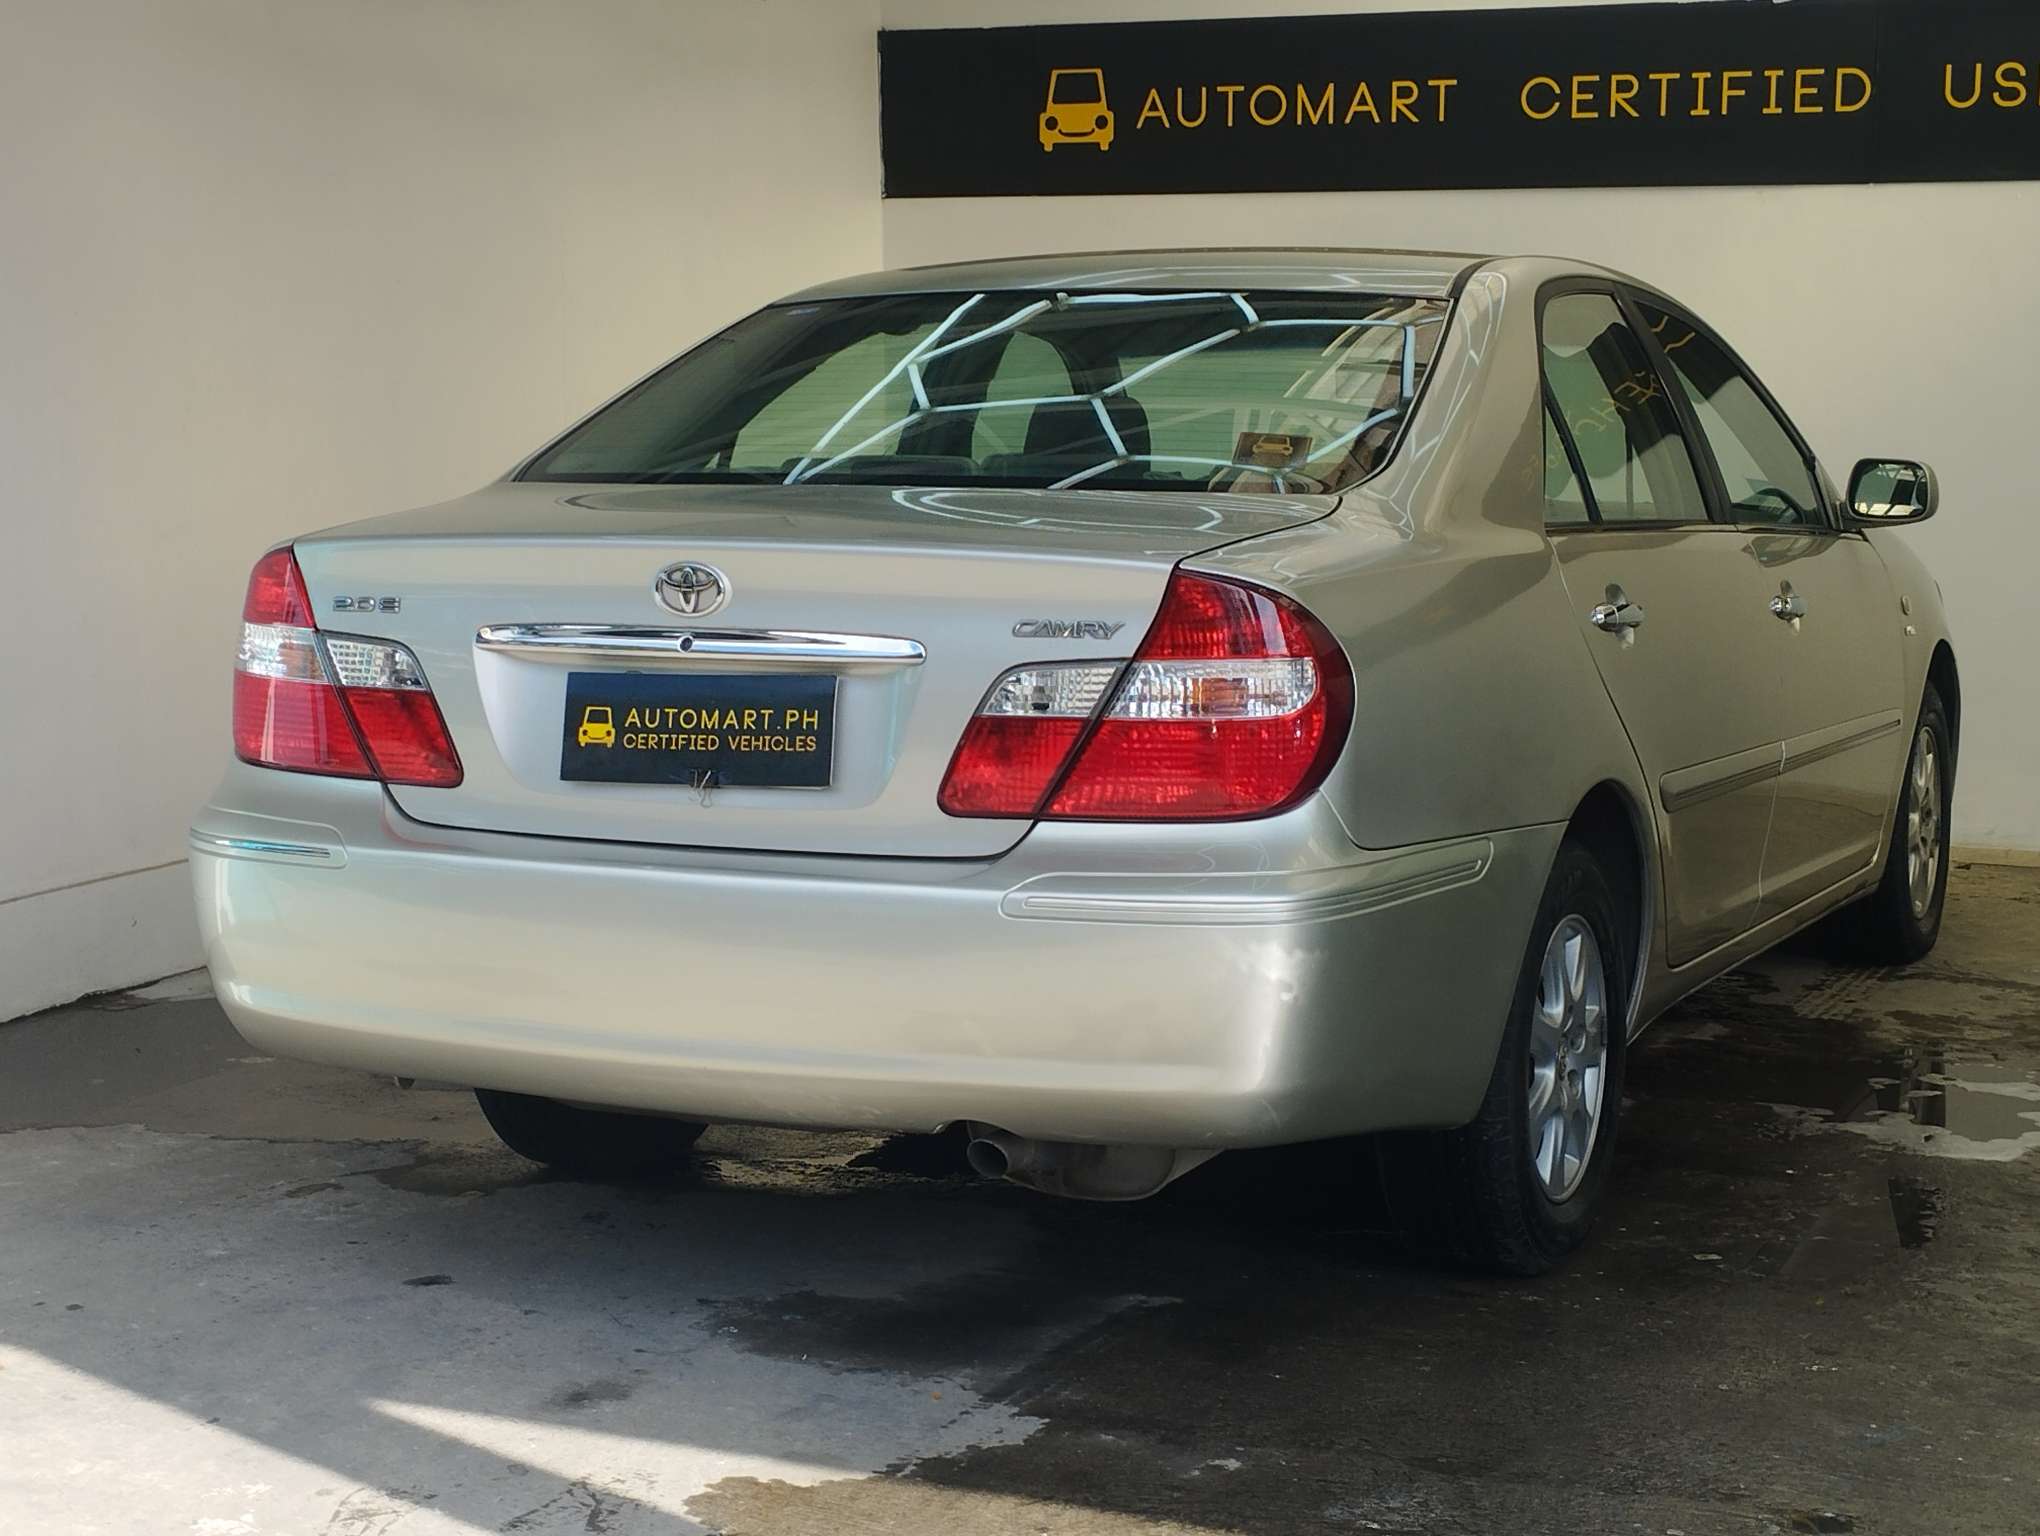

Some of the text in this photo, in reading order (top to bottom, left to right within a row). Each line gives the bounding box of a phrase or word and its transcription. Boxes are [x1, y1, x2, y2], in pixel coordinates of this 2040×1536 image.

[1135, 60, 2040, 130] AUTOMART CERTIFIED US
[1011, 618, 1126, 640] CAMRY
[624, 706, 819, 731] AUTOMART.PH
[622, 733, 818, 752] CERTIFIED VEHICLES
